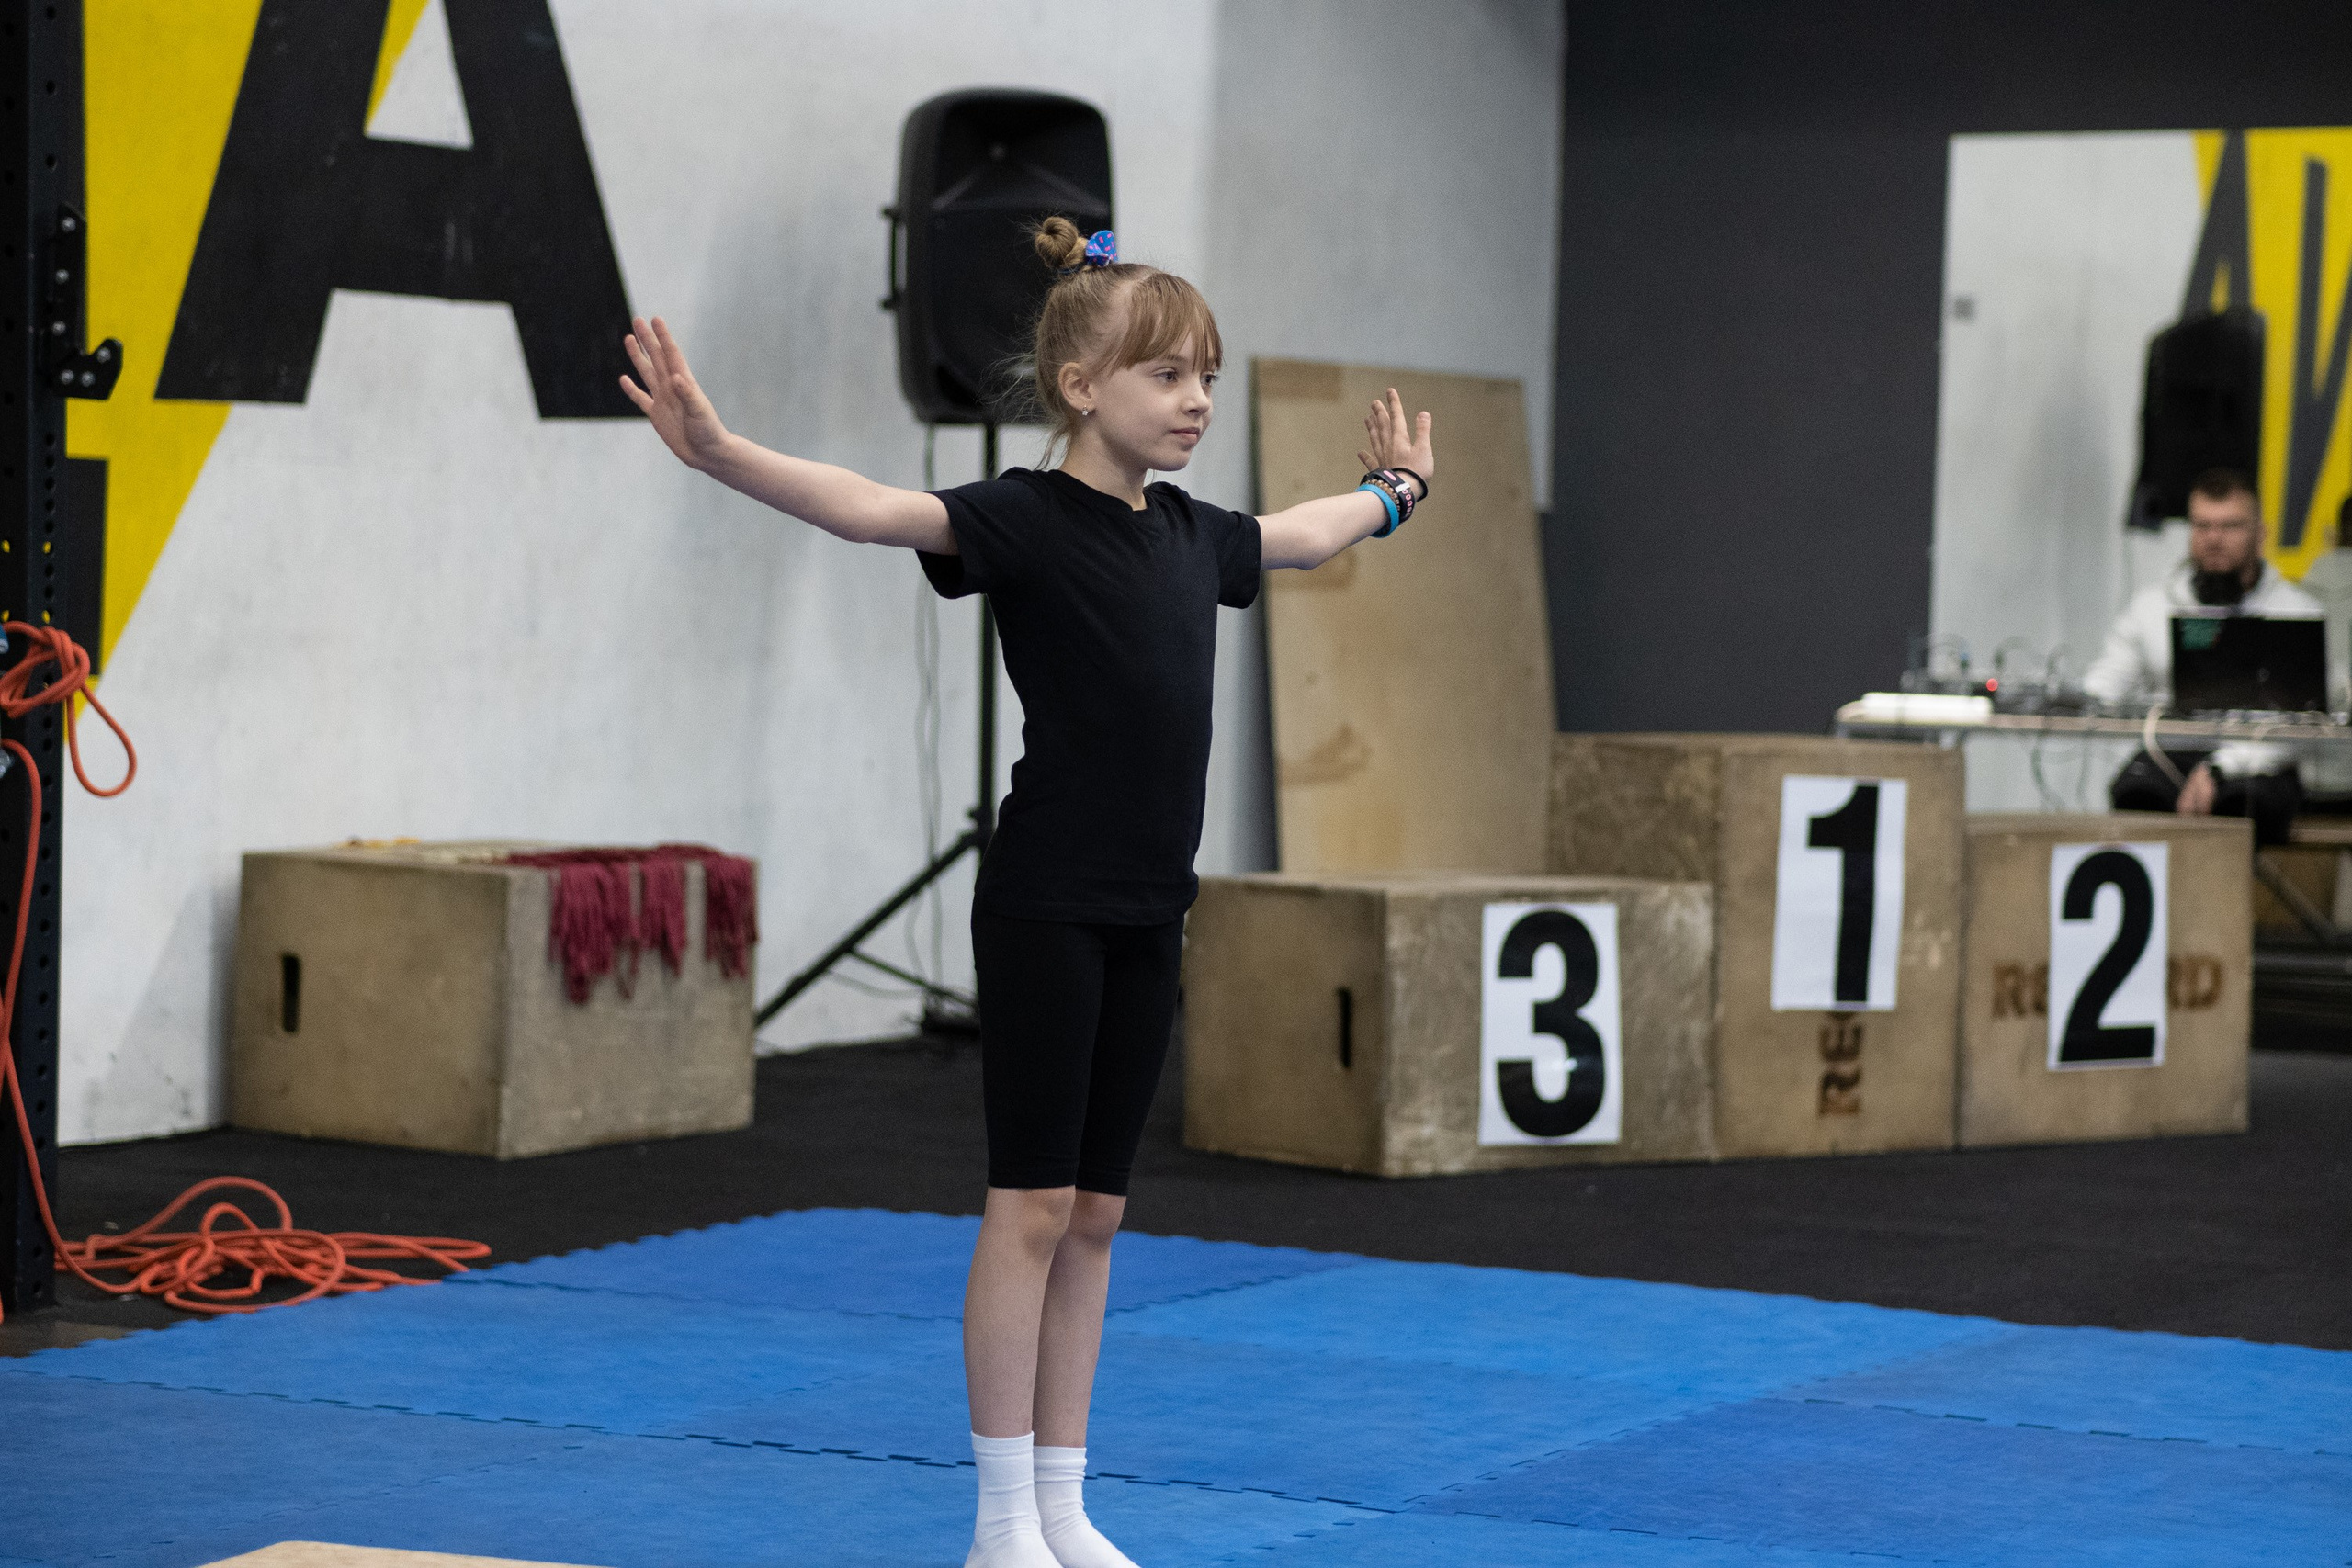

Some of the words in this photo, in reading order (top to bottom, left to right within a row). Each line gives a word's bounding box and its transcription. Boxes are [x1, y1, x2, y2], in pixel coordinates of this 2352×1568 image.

[1807, 784, 1880, 1001] 1
[2057, 850, 2156, 1064] 2
[1497, 909, 1606, 1138] 3
